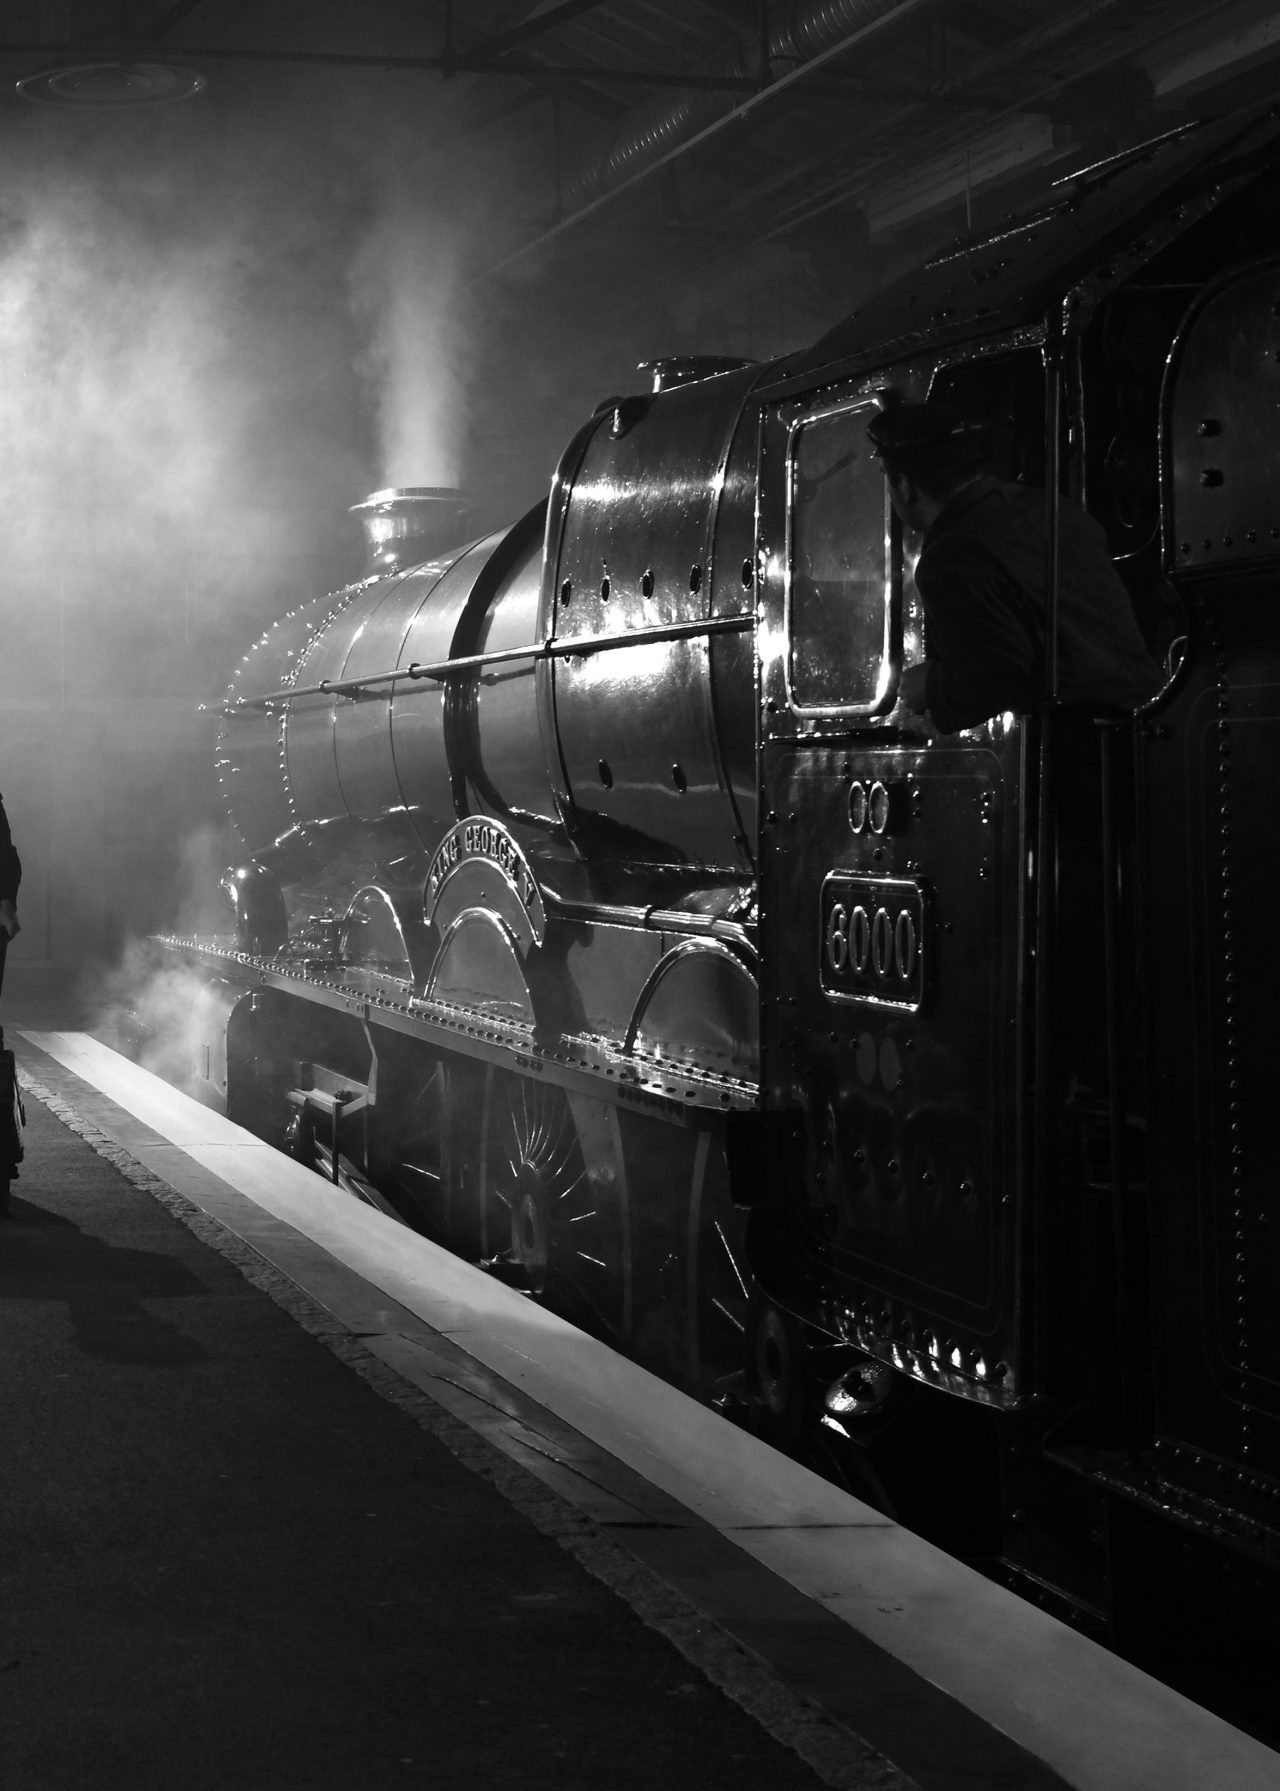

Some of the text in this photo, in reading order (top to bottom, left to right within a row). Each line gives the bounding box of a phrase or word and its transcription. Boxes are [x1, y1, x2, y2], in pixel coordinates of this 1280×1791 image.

[430, 834, 459, 894] KING
[464, 825, 518, 880] GEORGE
[826, 903, 917, 980] 6000
